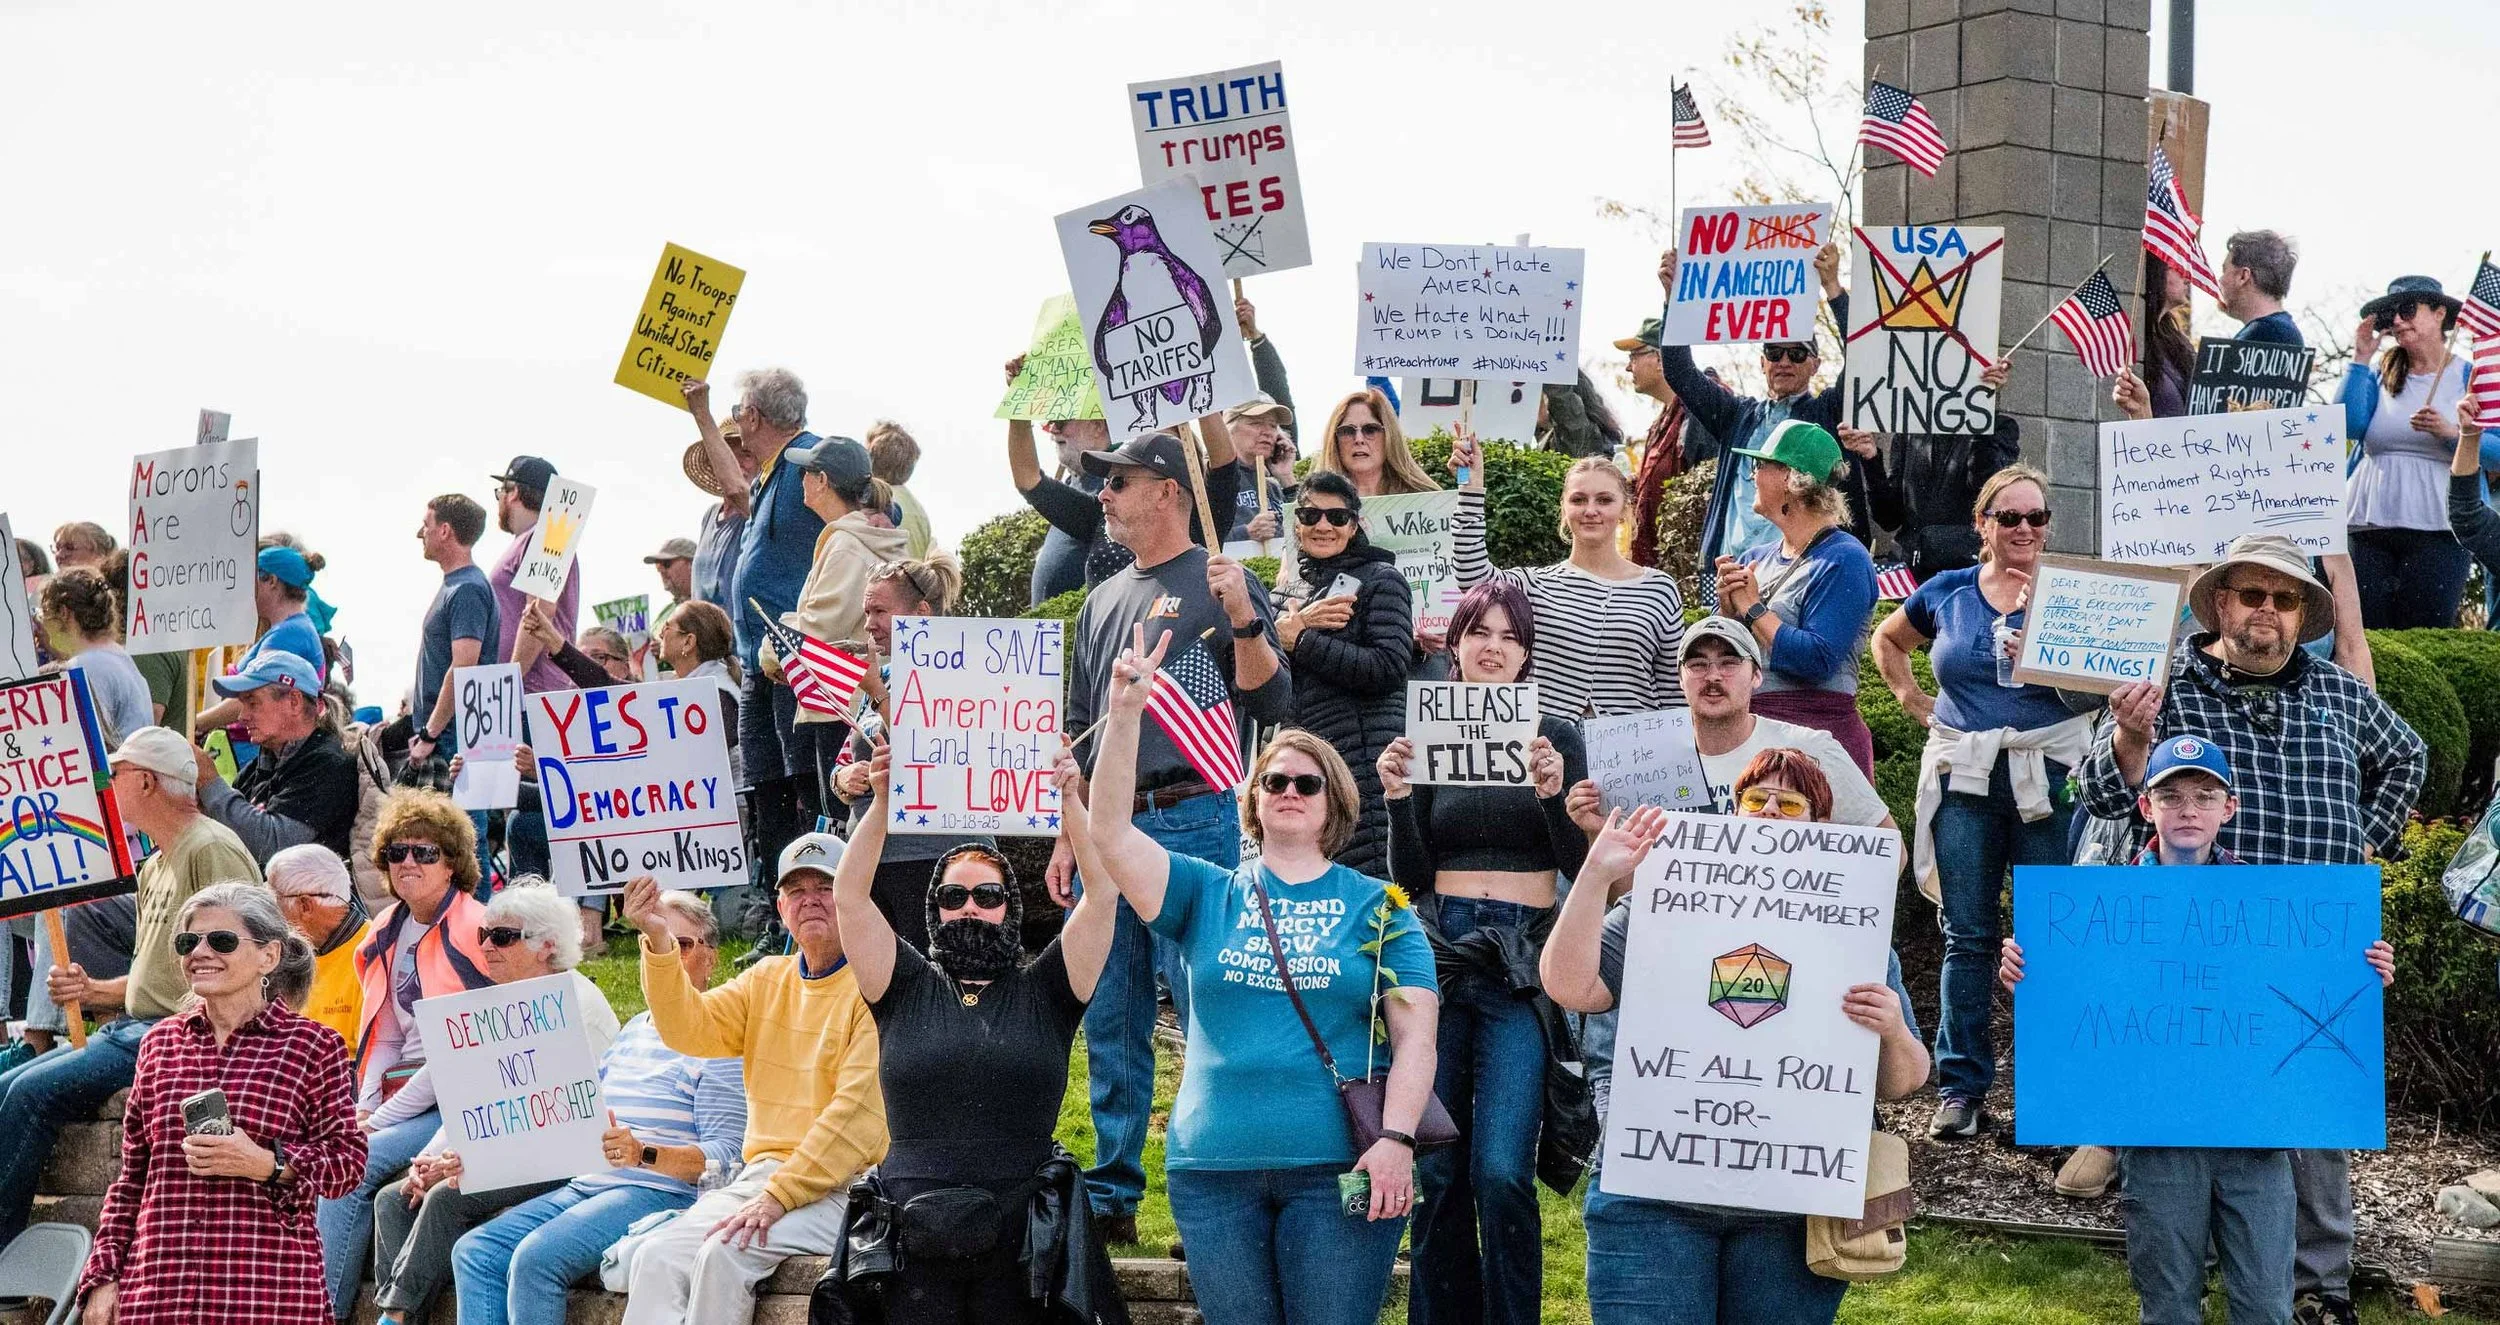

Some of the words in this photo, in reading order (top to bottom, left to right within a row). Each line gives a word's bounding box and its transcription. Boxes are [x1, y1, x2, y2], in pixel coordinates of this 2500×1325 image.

[1136, 72, 1287, 128] TRUTH
[1160, 125, 1286, 168] trumps
[1200, 176, 1285, 221] IES
[1688, 211, 1740, 256] NO
[1745, 212, 1817, 250] KINGS
[1892, 225, 1968, 259] USA
[1379, 247, 1411, 269] We
[1496, 251, 1552, 273] Hate
[664, 256, 686, 285] No
[690, 265, 737, 308] Troops
[1421, 276, 1520, 296] AMERICA
[1677, 262, 1711, 302] IN
[1711, 259, 1806, 300] AMERICA
[659, 291, 716, 328] Against
[1373, 304, 1406, 325] We
[1415, 302, 1469, 323] Hate
[1480, 305, 1530, 324] What
[1705, 299, 1791, 341] EVER
[637, 313, 679, 347] United
[1134, 316, 1175, 353] NO
[1373, 327, 1441, 341] TRUMP
[1019, 356, 1079, 376] HUMAN
[1028, 366, 1093, 388] RIGHTS
[1113, 341, 1202, 390] TARIFFS
[1887, 331, 1971, 393] NO
[2201, 344, 2231, 374] IT
[1011, 382, 1078, 400] BELONG
[1852, 376, 1996, 434] KINGS
[2188, 384, 2225, 416] HAVE
[133, 460, 229, 499] Morons
[2112, 474, 2200, 497] Amendment
[2209, 461, 2270, 486] Rights
[2285, 453, 2335, 475] time
[560, 489, 577, 505] NO
[2153, 499, 2191, 516] the
[2251, 489, 2339, 513] Amendment
[132, 505, 180, 546] Are
[132, 552, 237, 590] Governing
[528, 562, 562, 590] KINGS
[1403, 565, 1424, 580] my
[1428, 556, 1453, 582] righ
[2051, 578, 2081, 589] DEAR
[132, 597, 216, 637] America
[2047, 595, 2081, 606] CHECK
[2086, 598, 2156, 612] EXECUTIVE
[2038, 632, 2077, 644] UPHOLD
[2043, 621, 2091, 634] ENABLE
[911, 630, 966, 670] God
[985, 628, 1060, 676] SAVE
[2038, 645, 2070, 666] NO
[893, 669, 1058, 733] America
[1418, 686, 1531, 723] RELEASE
[541, 690, 648, 757] YES
[658, 697, 707, 739] TO
[1457, 724, 1491, 740] THE
[1586, 721, 1639, 744] Ignoring
[4, 733, 23, 758] &
[912, 729, 970, 765] Land
[987, 731, 1043, 770] that
[1426, 740, 1527, 784] FILES
[1632, 746, 1654, 762] the
[538, 757, 717, 828] DEMOCRACY
[904, 765, 938, 811] I
[967, 767, 1058, 813] LOVE
[1601, 768, 1668, 793] Germans
[1676, 760, 1693, 778] Did
[0, 791, 72, 841] OR
[941, 813, 1000, 829] 10-18-25
[1652, 820, 1746, 855] WHEN
[1752, 824, 1896, 859] SOMEONE
[0, 838, 89, 897] ALL!
[1664, 858, 1774, 891] ATTACKS
[1782, 869, 1845, 893] ONE
[1651, 887, 1746, 919] PARTY
[1753, 896, 1880, 928] MEMBER
[2048, 891, 2163, 948] RAGE
[2180, 896, 2357, 949] AGAINST
[1223, 970, 1244, 982] NO
[1246, 974, 1331, 992] EXCETIONS
[1741, 977, 1764, 993] 20
[2150, 959, 2223, 991] THE
[446, 991, 566, 1049] DEMOCRACY
[2071, 1003, 2264, 1049] MACHINE
[498, 1049, 536, 1089] NOT
[1630, 1046, 1690, 1080] WE
[1700, 1055, 1763, 1082] ALL
[1777, 1055, 1863, 1095] ROLL
[462, 1079, 597, 1141] DICTATORSHIP
[1620, 1127, 1857, 1184] INITIATIVE
